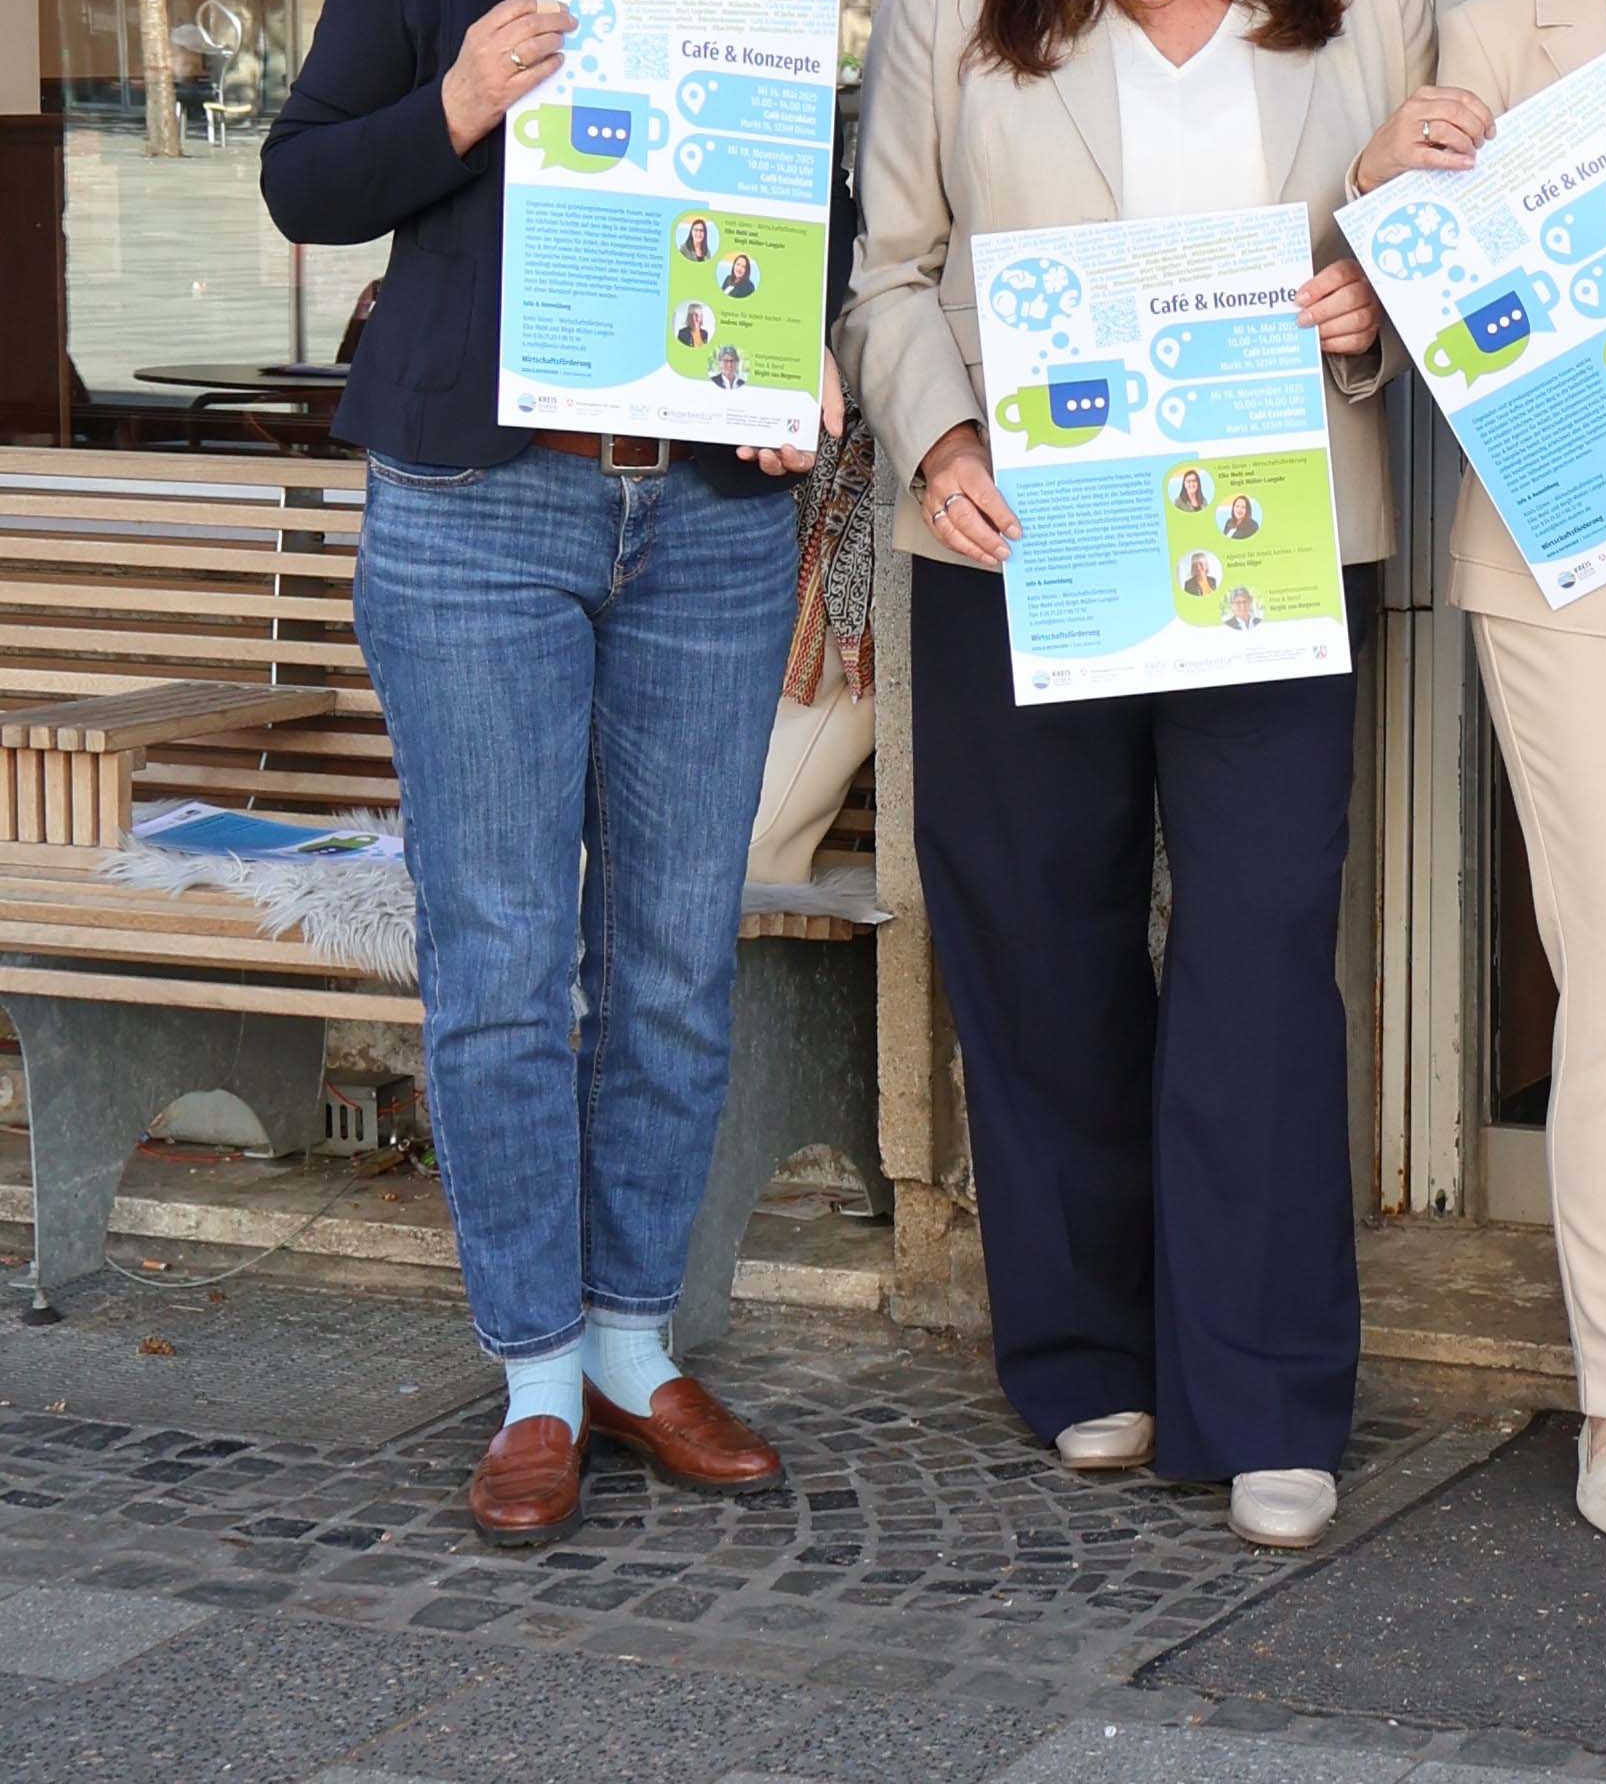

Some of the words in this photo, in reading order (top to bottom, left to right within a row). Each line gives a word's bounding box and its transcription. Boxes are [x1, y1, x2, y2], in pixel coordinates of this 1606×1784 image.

[682, 40, 720, 60] Café
[724, 45, 737, 63] &
[743, 48, 821, 75] Konzepte
[1523, 180, 1560, 212] Café
[1561, 173, 1577, 191] &
[1150, 294, 1189, 315] Café
[1195, 293, 1208, 311] &
[1214, 287, 1297, 309] Konzepte
